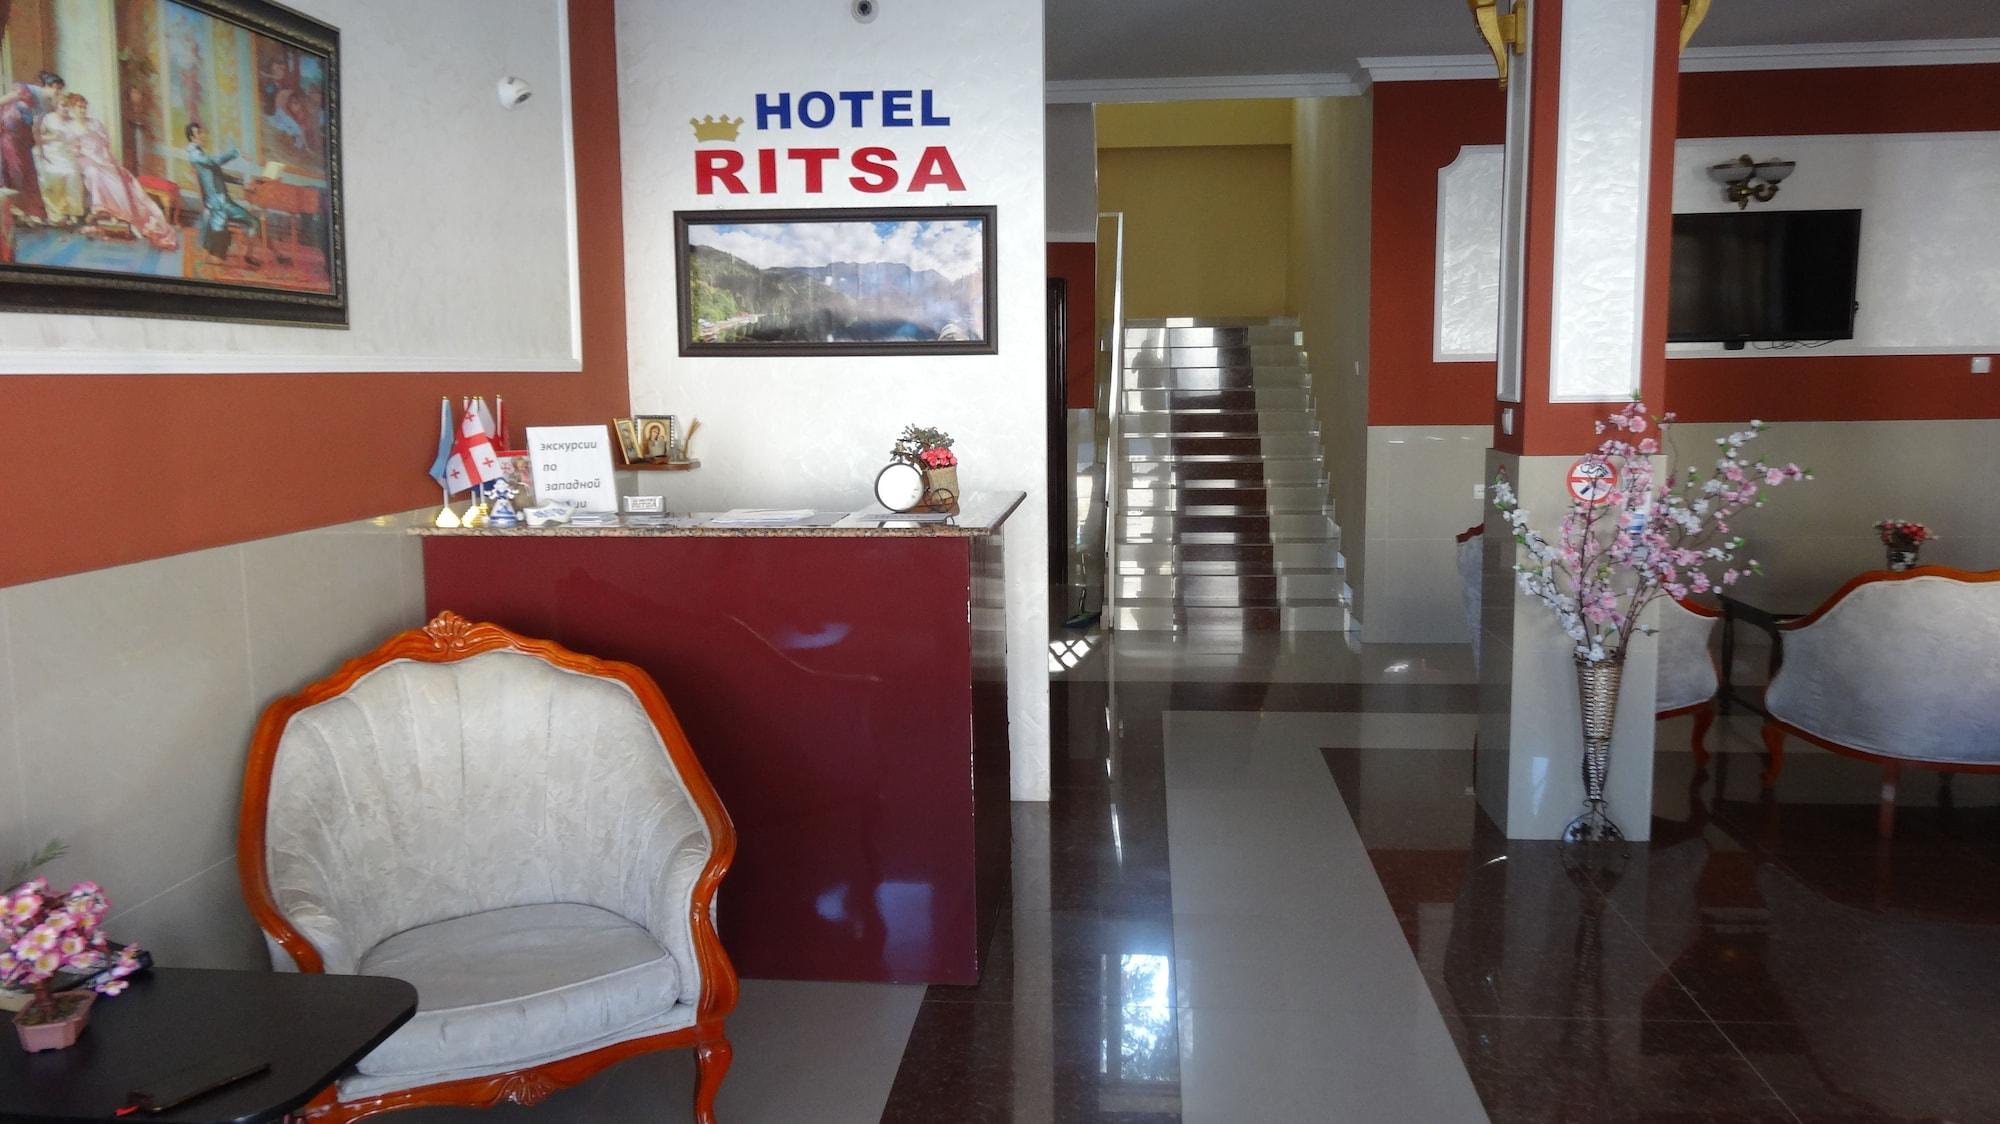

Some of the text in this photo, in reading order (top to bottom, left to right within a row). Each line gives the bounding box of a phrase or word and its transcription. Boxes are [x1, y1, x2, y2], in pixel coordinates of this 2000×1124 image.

[755, 90, 951, 130] HOTEL
[694, 146, 967, 195] RITSA
[540, 441, 597, 452] экскурсии
[543, 463, 557, 471] по
[545, 478, 601, 491] западной
